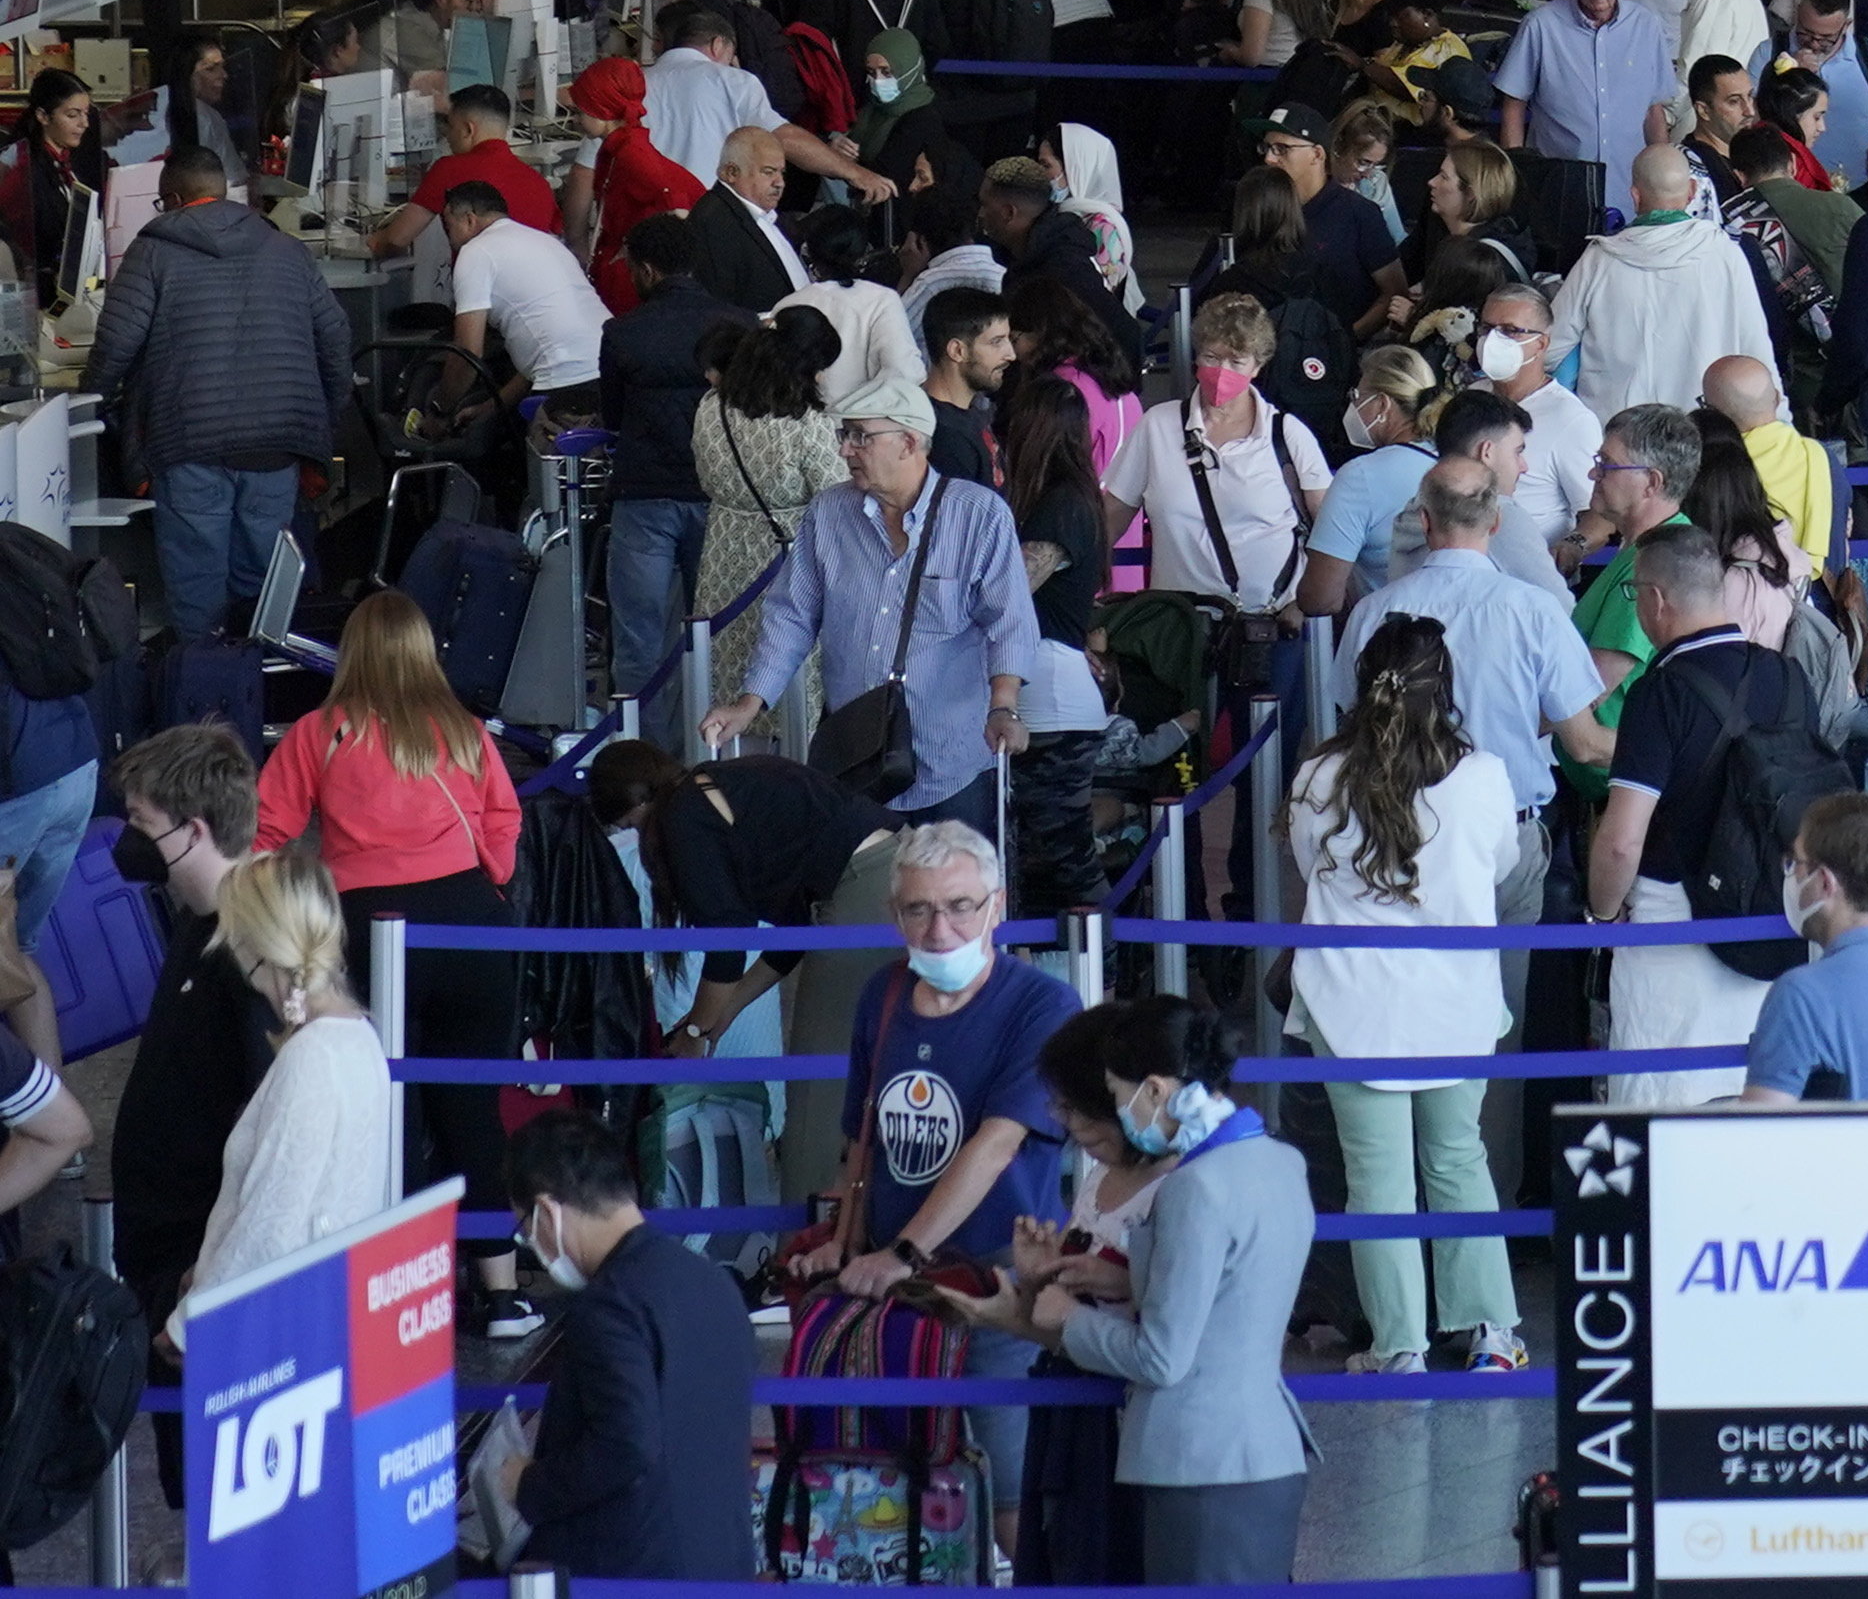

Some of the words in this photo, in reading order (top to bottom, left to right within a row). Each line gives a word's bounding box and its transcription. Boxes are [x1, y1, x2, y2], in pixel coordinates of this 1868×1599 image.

[368, 1244, 451, 1316] BUSINESS
[1680, 1240, 1827, 1292] ANA
[395, 1287, 451, 1345] CLASS
[205, 1363, 342, 1541] LOT
